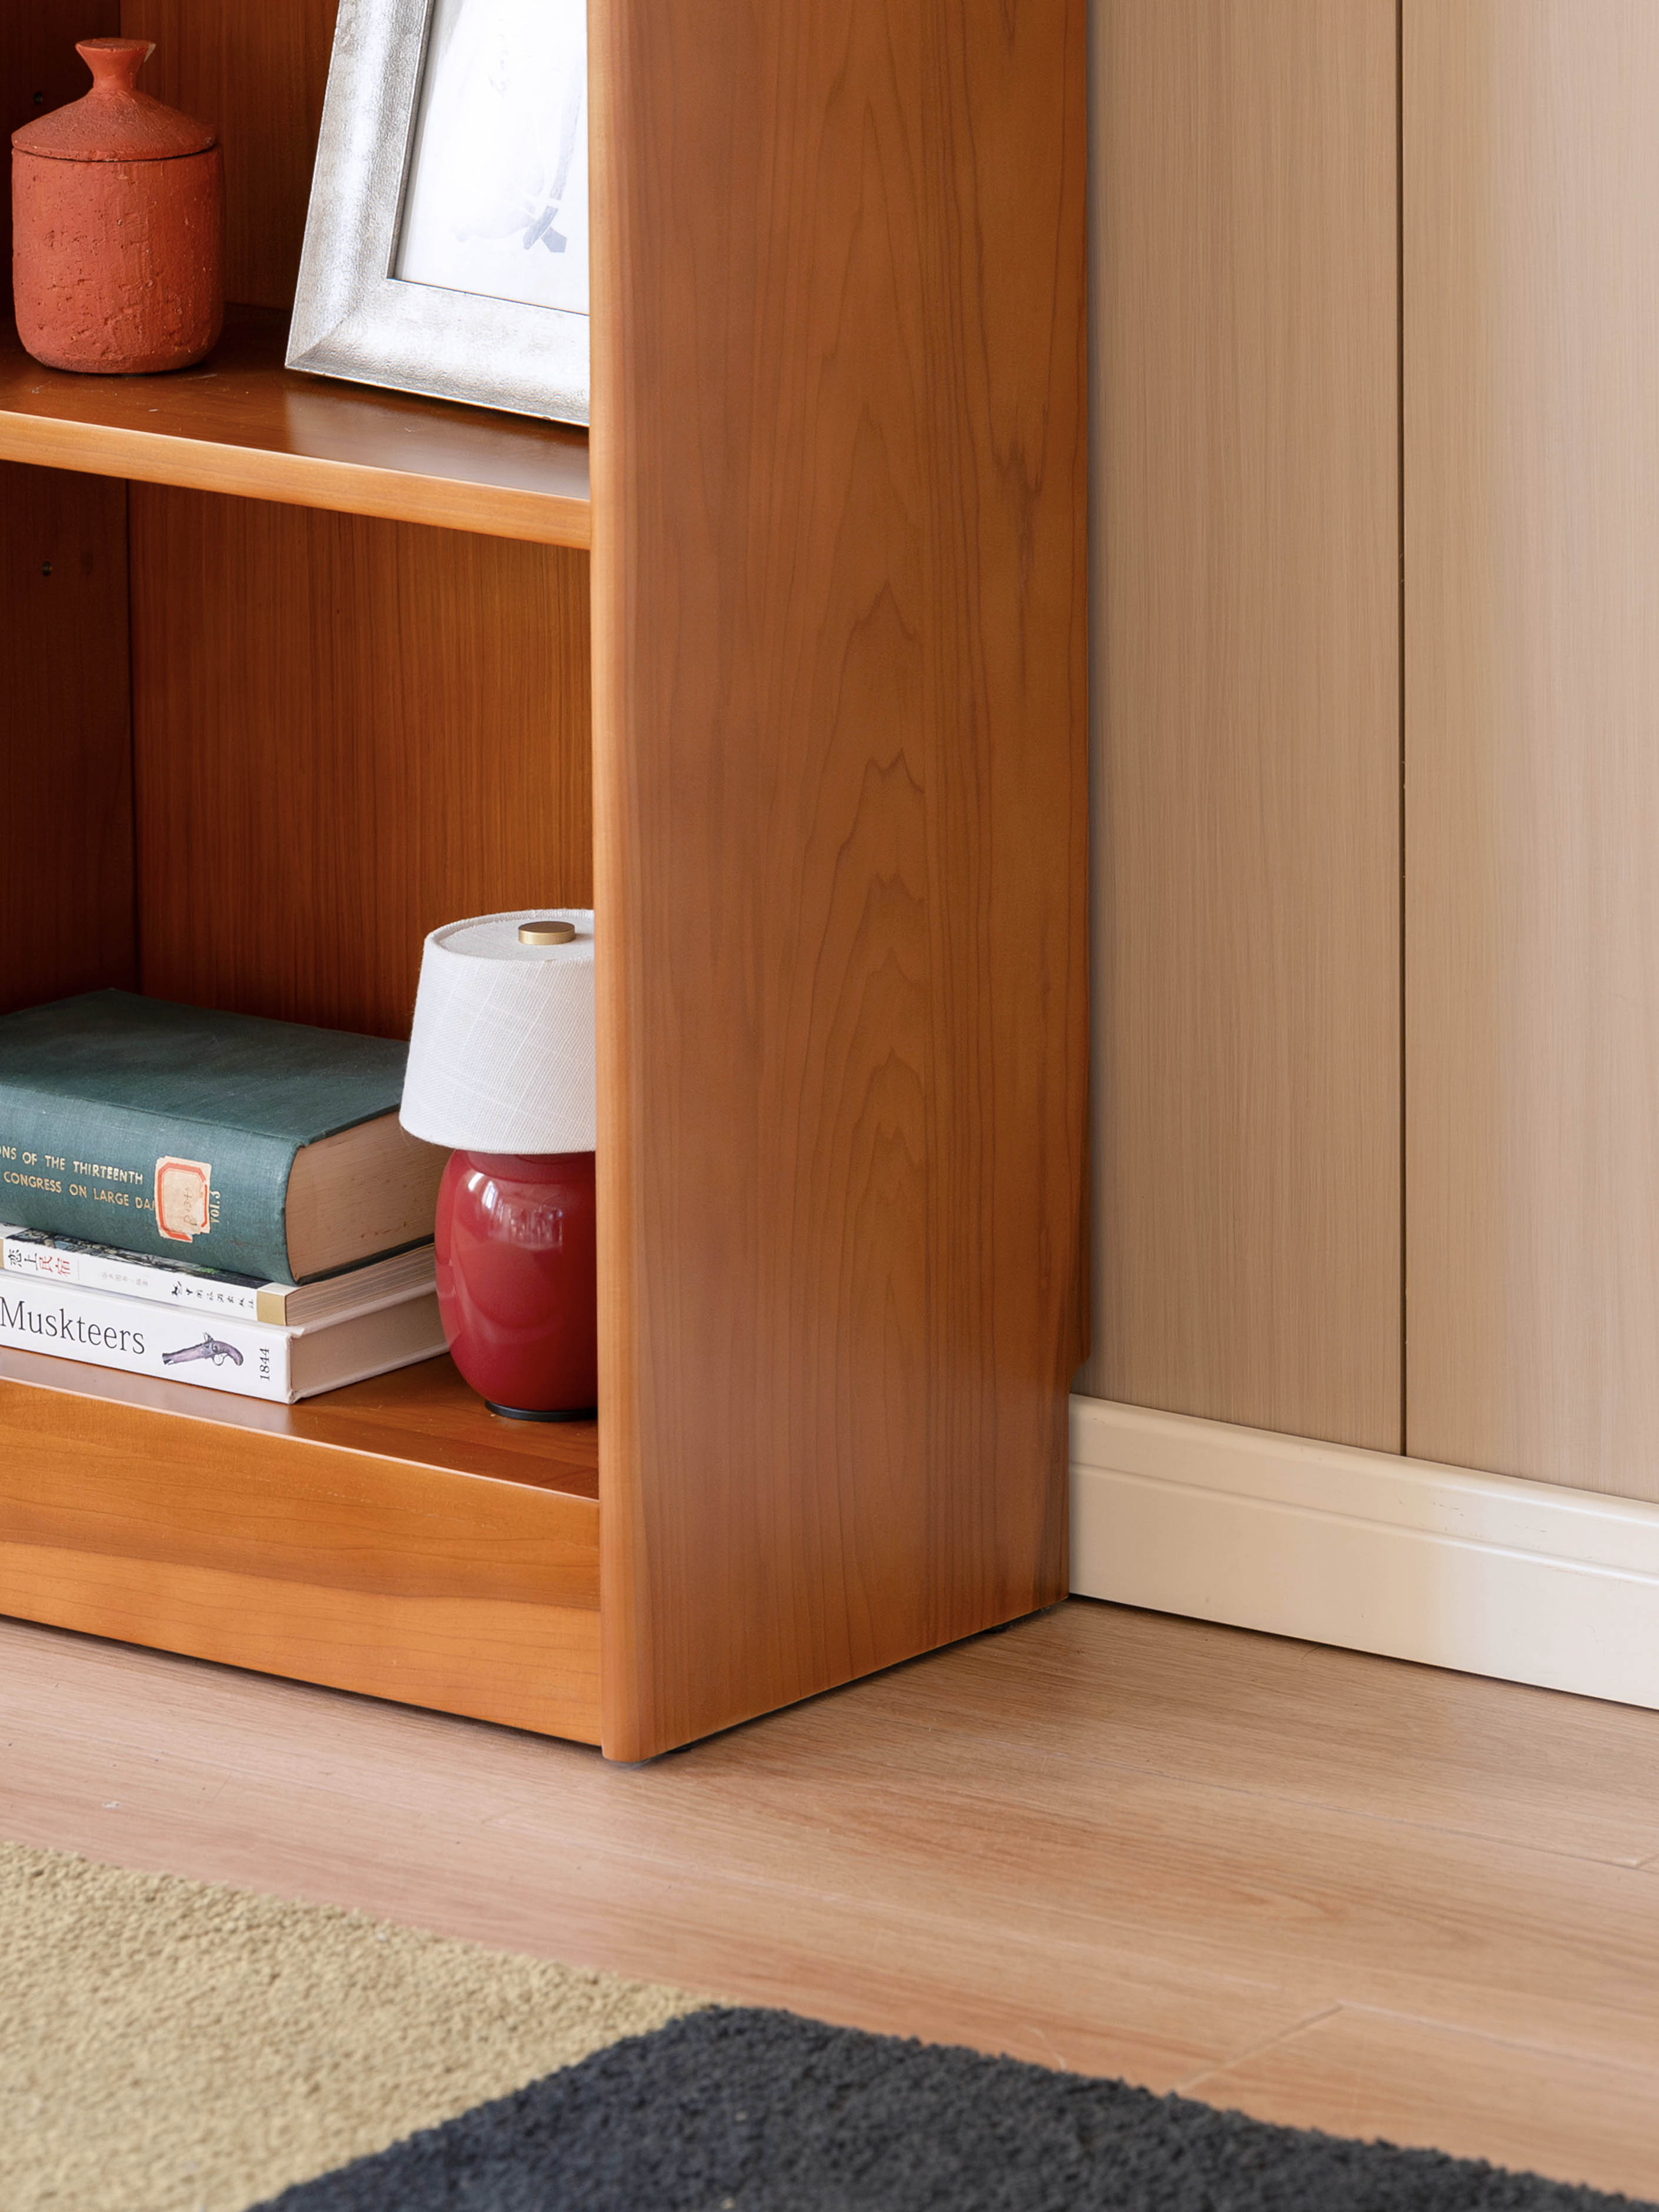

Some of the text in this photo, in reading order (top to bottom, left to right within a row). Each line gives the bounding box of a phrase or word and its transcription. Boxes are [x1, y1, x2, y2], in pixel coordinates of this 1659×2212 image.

[0, 1145, 144, 1185] NS OF THE THIRTEENTH
[4, 1171, 62, 1193] CONGRESS
[69, 1183, 87, 1198] ON
[93, 1187, 129, 1207] LARGE
[8, 1248, 71, 1276] 恋上民宿
[0, 1296, 145, 1355] Muskteers
[259, 1348, 270, 1381] 1844
